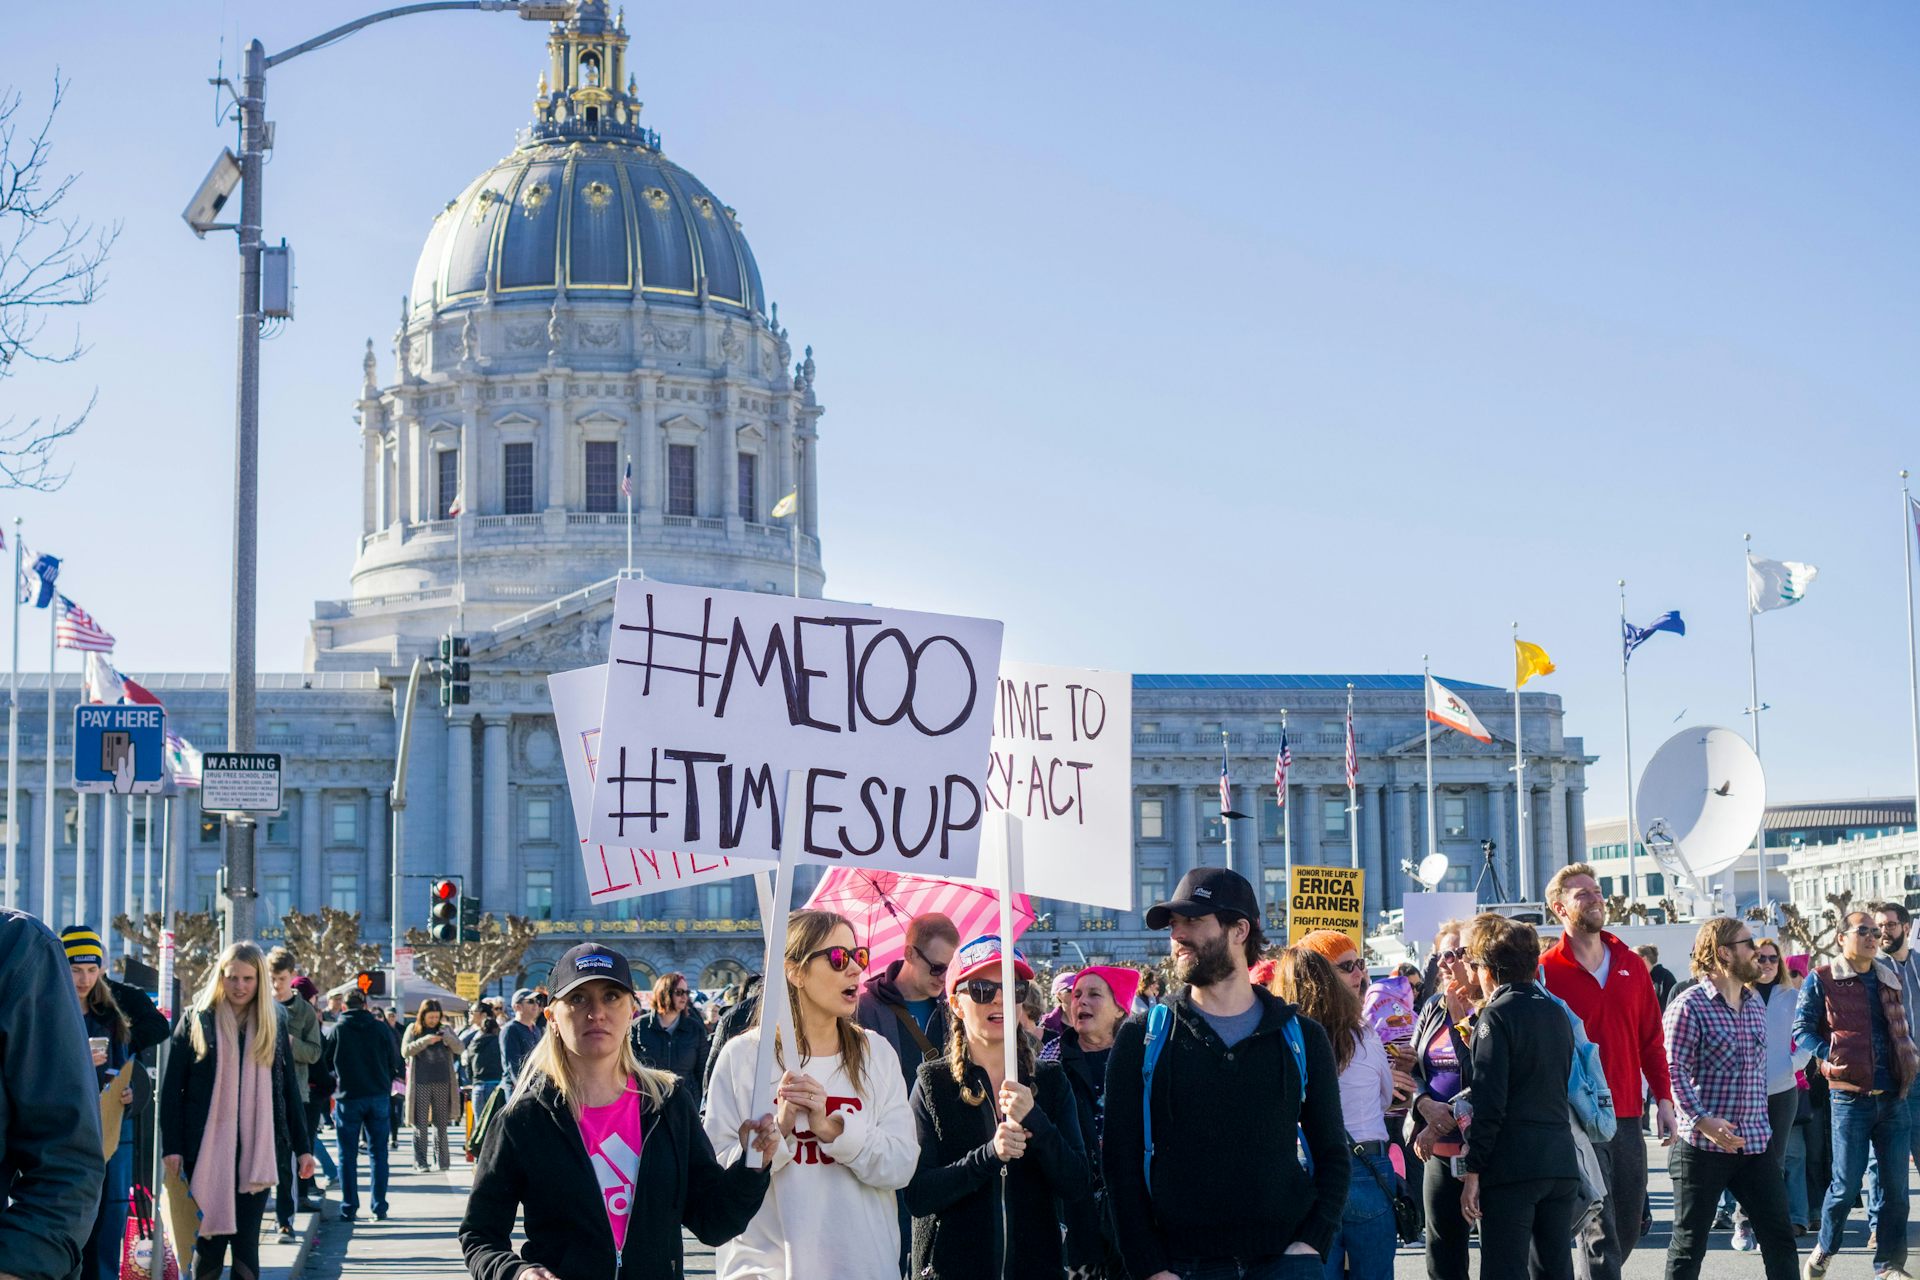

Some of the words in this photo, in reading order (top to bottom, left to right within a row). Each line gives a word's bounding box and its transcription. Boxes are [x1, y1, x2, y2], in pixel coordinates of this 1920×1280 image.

[616, 594, 978, 737] #METOO
[992, 676, 1053, 741] IME
[1065, 684, 1106, 742] TO
[81, 711, 111, 728] PAY
[115, 711, 160, 728] HERE
[207, 757, 276, 770] WARNING
[206, 771, 222, 779] DRUG
[223, 771, 238, 779] FREE
[607, 746, 982, 859] #TIMESUP
[1296, 869, 1320, 877] HONOR
[1321, 870, 1334, 878] THE
[1349, 871, 1358, 879] OF
[1299, 878, 1354, 896] ERICA
[1292, 895, 1360, 913] GARNER
[1293, 916, 1321, 925] FIGHT
[1322, 917, 1359, 928] RACISM
